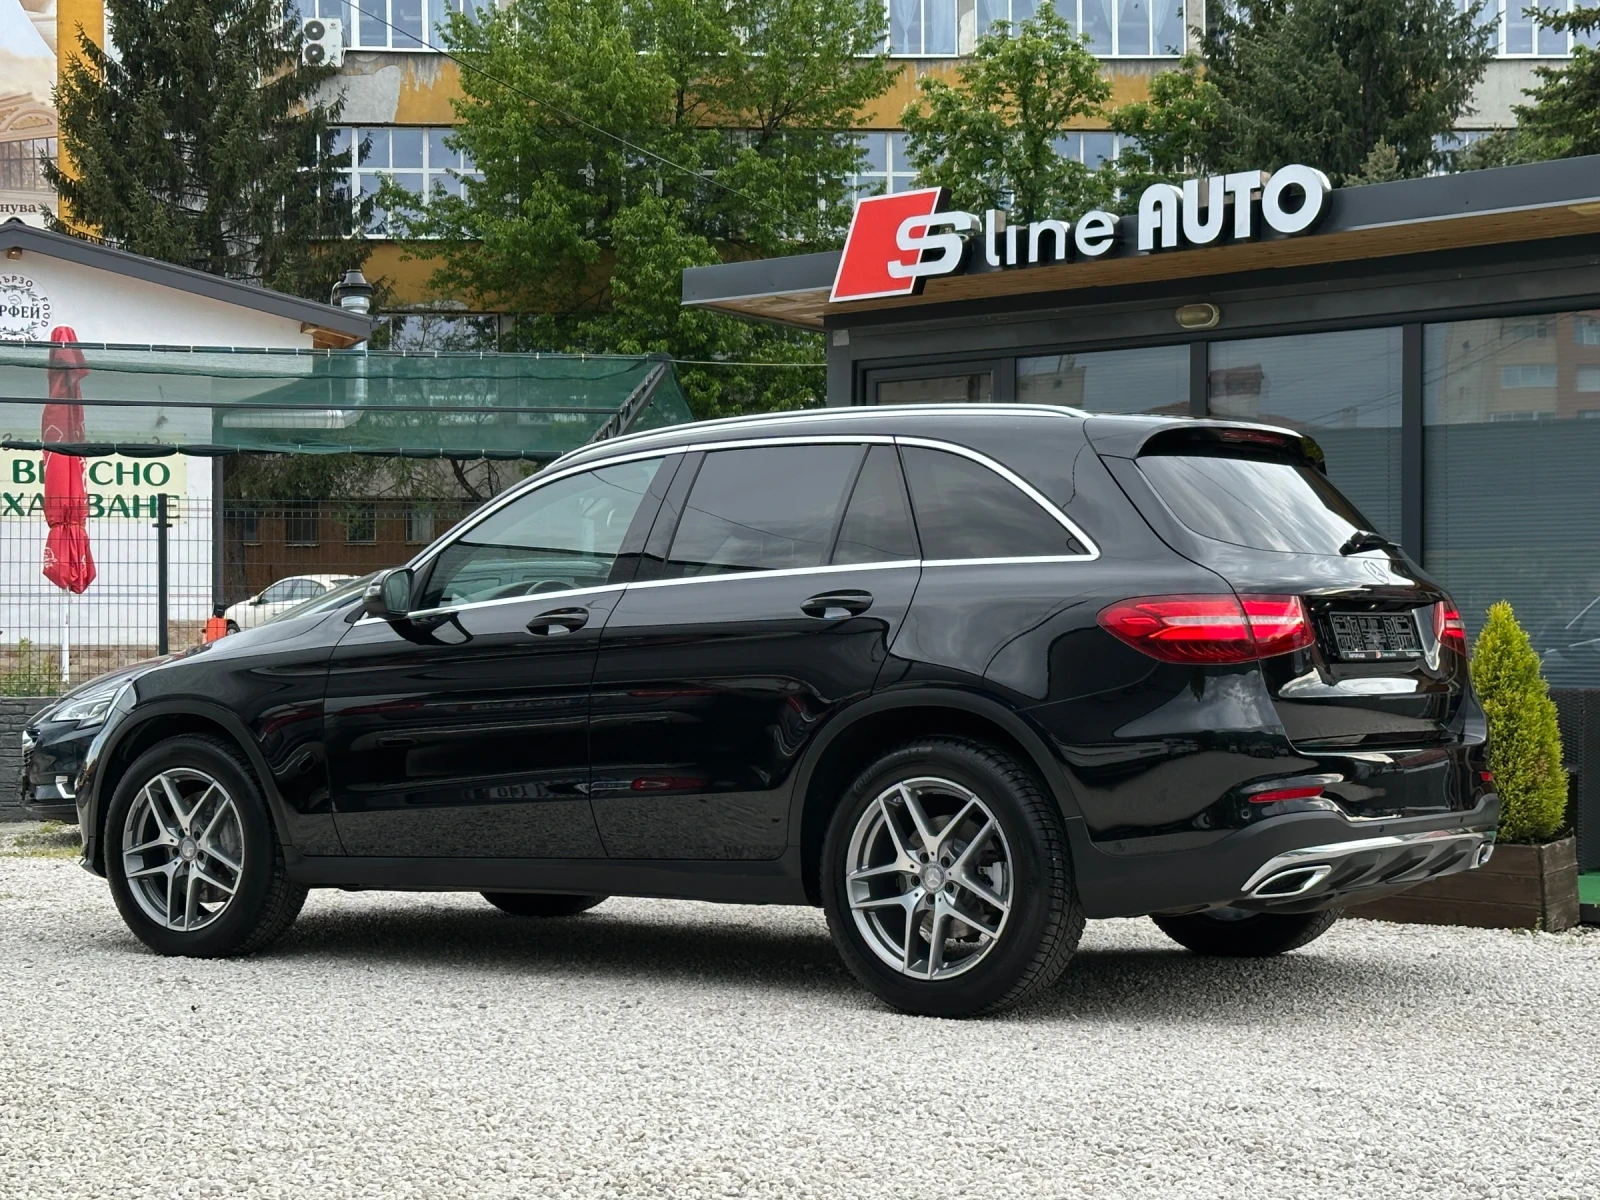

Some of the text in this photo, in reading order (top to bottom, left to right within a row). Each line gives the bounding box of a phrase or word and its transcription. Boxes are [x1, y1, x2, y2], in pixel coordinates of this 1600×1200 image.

[985, 209, 1115, 267] line
[1137, 163, 1325, 251] AUTO
[0, 275, 33, 287] ЪРЗО
[40, 296, 51, 328] FOOD
[12, 459, 171, 486] ВСНО
[2, 491, 181, 519] ХАВАНЕ
